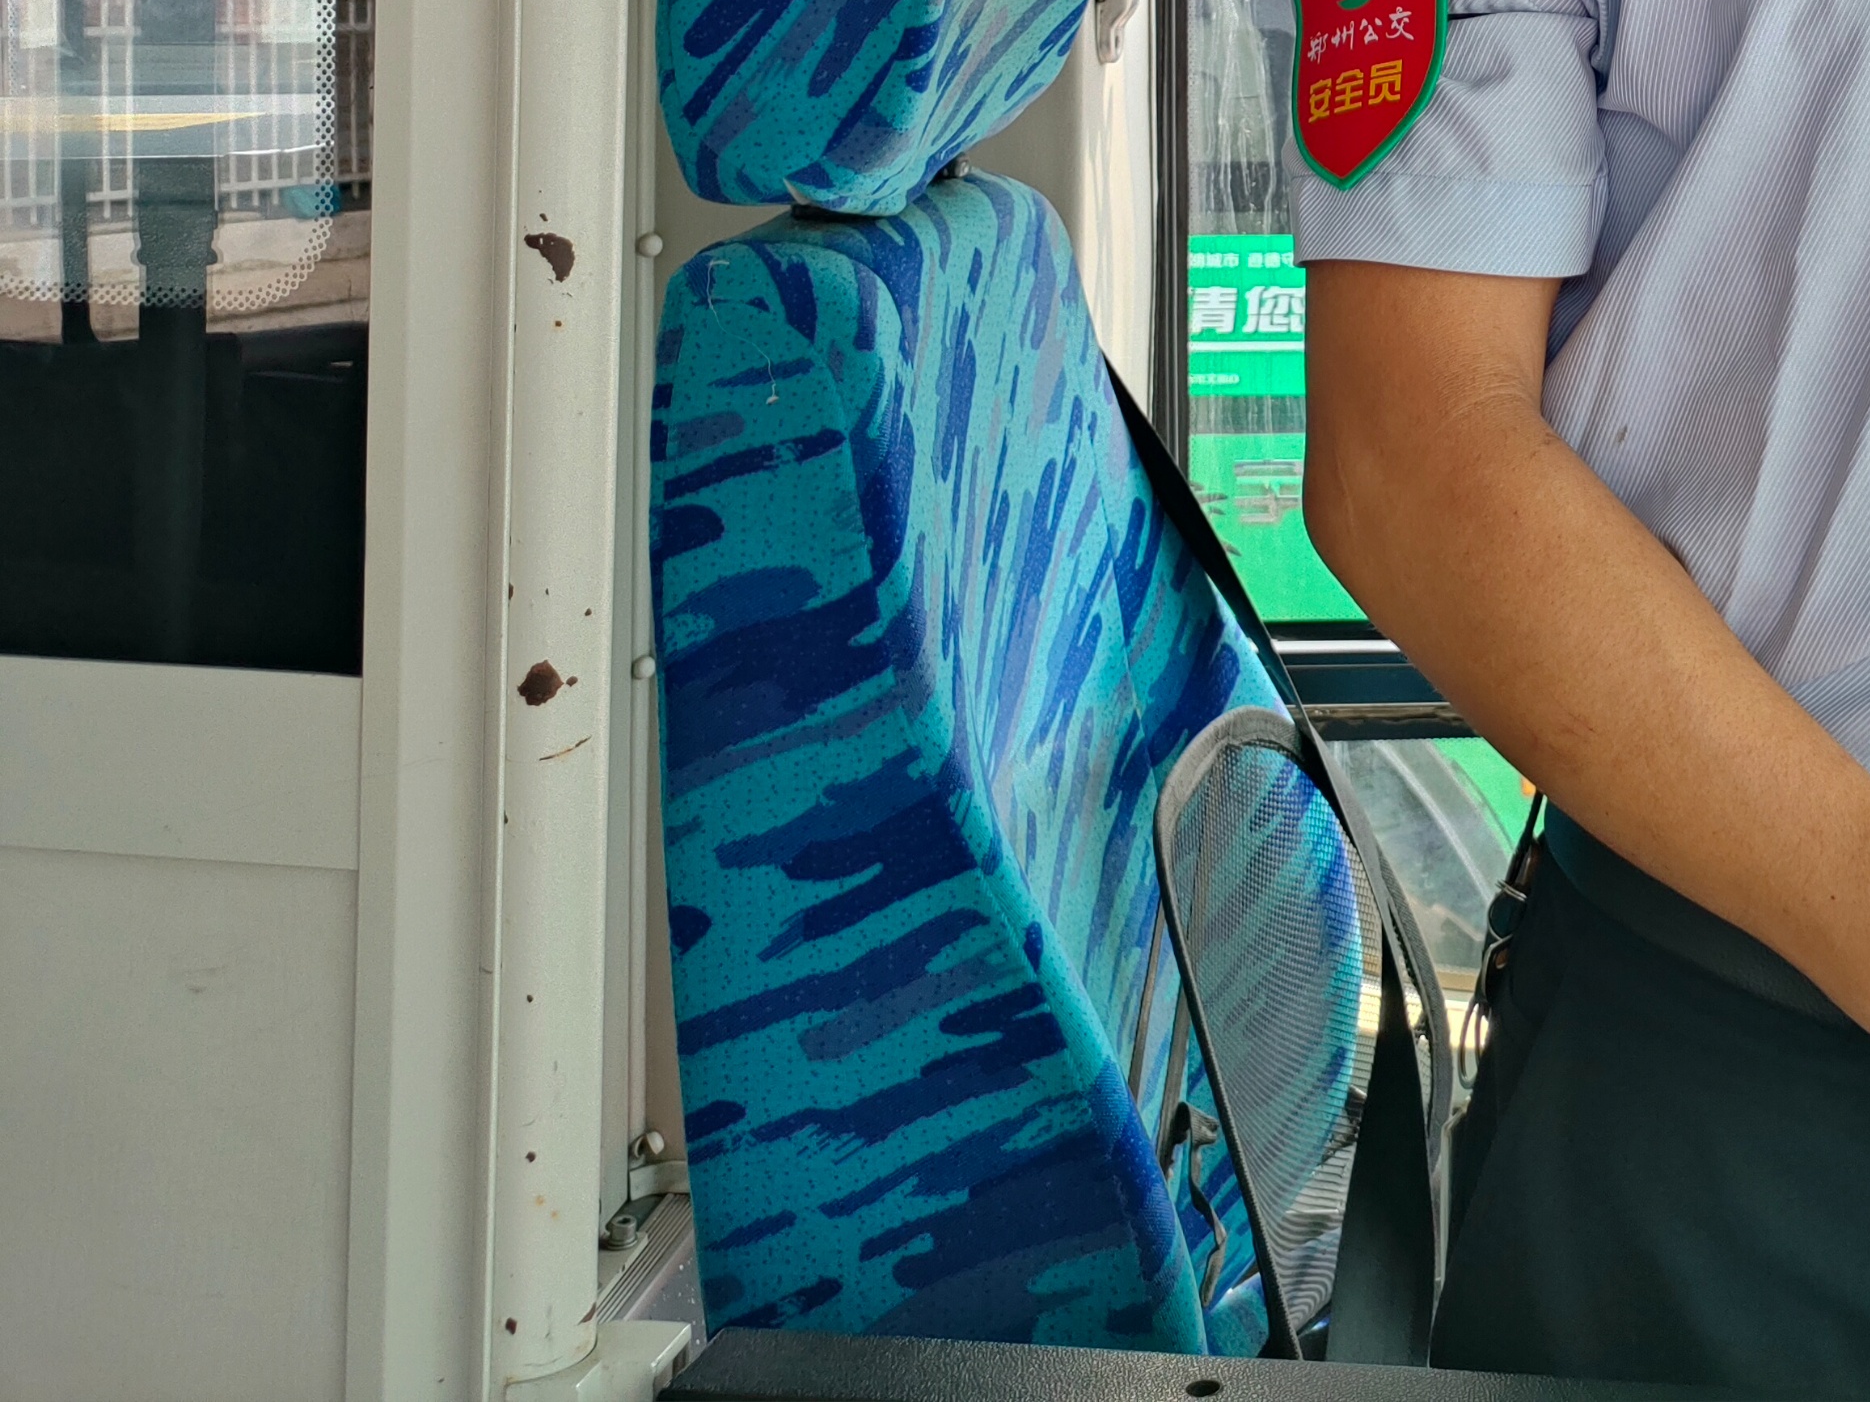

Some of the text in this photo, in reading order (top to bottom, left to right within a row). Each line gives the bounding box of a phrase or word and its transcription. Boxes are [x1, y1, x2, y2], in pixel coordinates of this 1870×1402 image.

[1307, 6, 1415, 64] 郑州公交
[1308, 59, 1403, 124] 安全员
